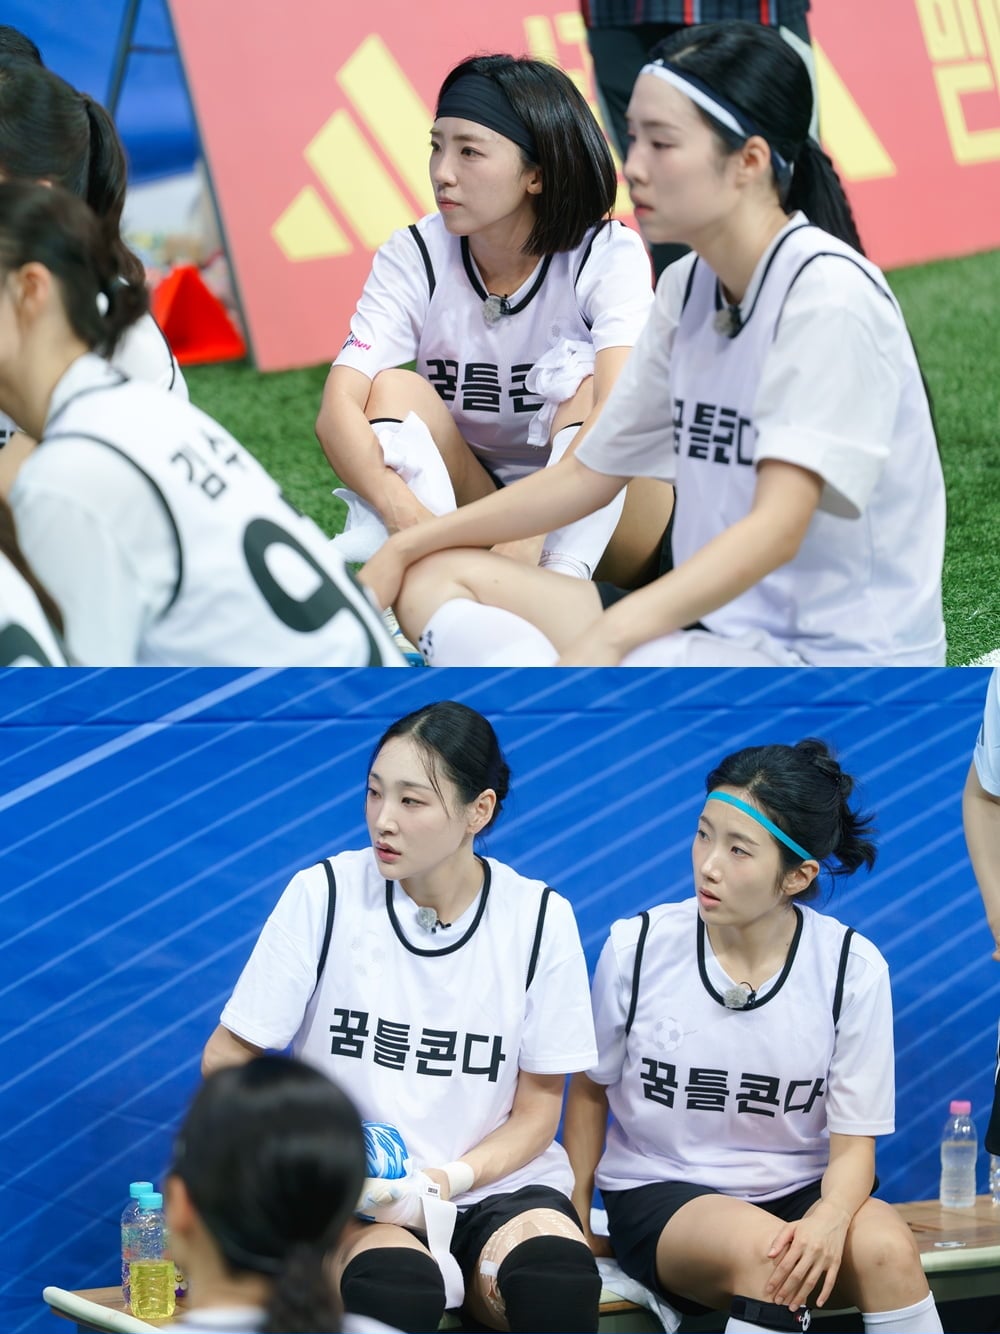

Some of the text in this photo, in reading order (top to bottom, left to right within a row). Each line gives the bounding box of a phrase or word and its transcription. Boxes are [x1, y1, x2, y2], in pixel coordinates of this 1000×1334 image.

[243, 517, 384, 667] 9
[329, 1007, 506, 1082] 꿈틀콘다
[640, 1057, 825, 1118] 꿈틀콘다
